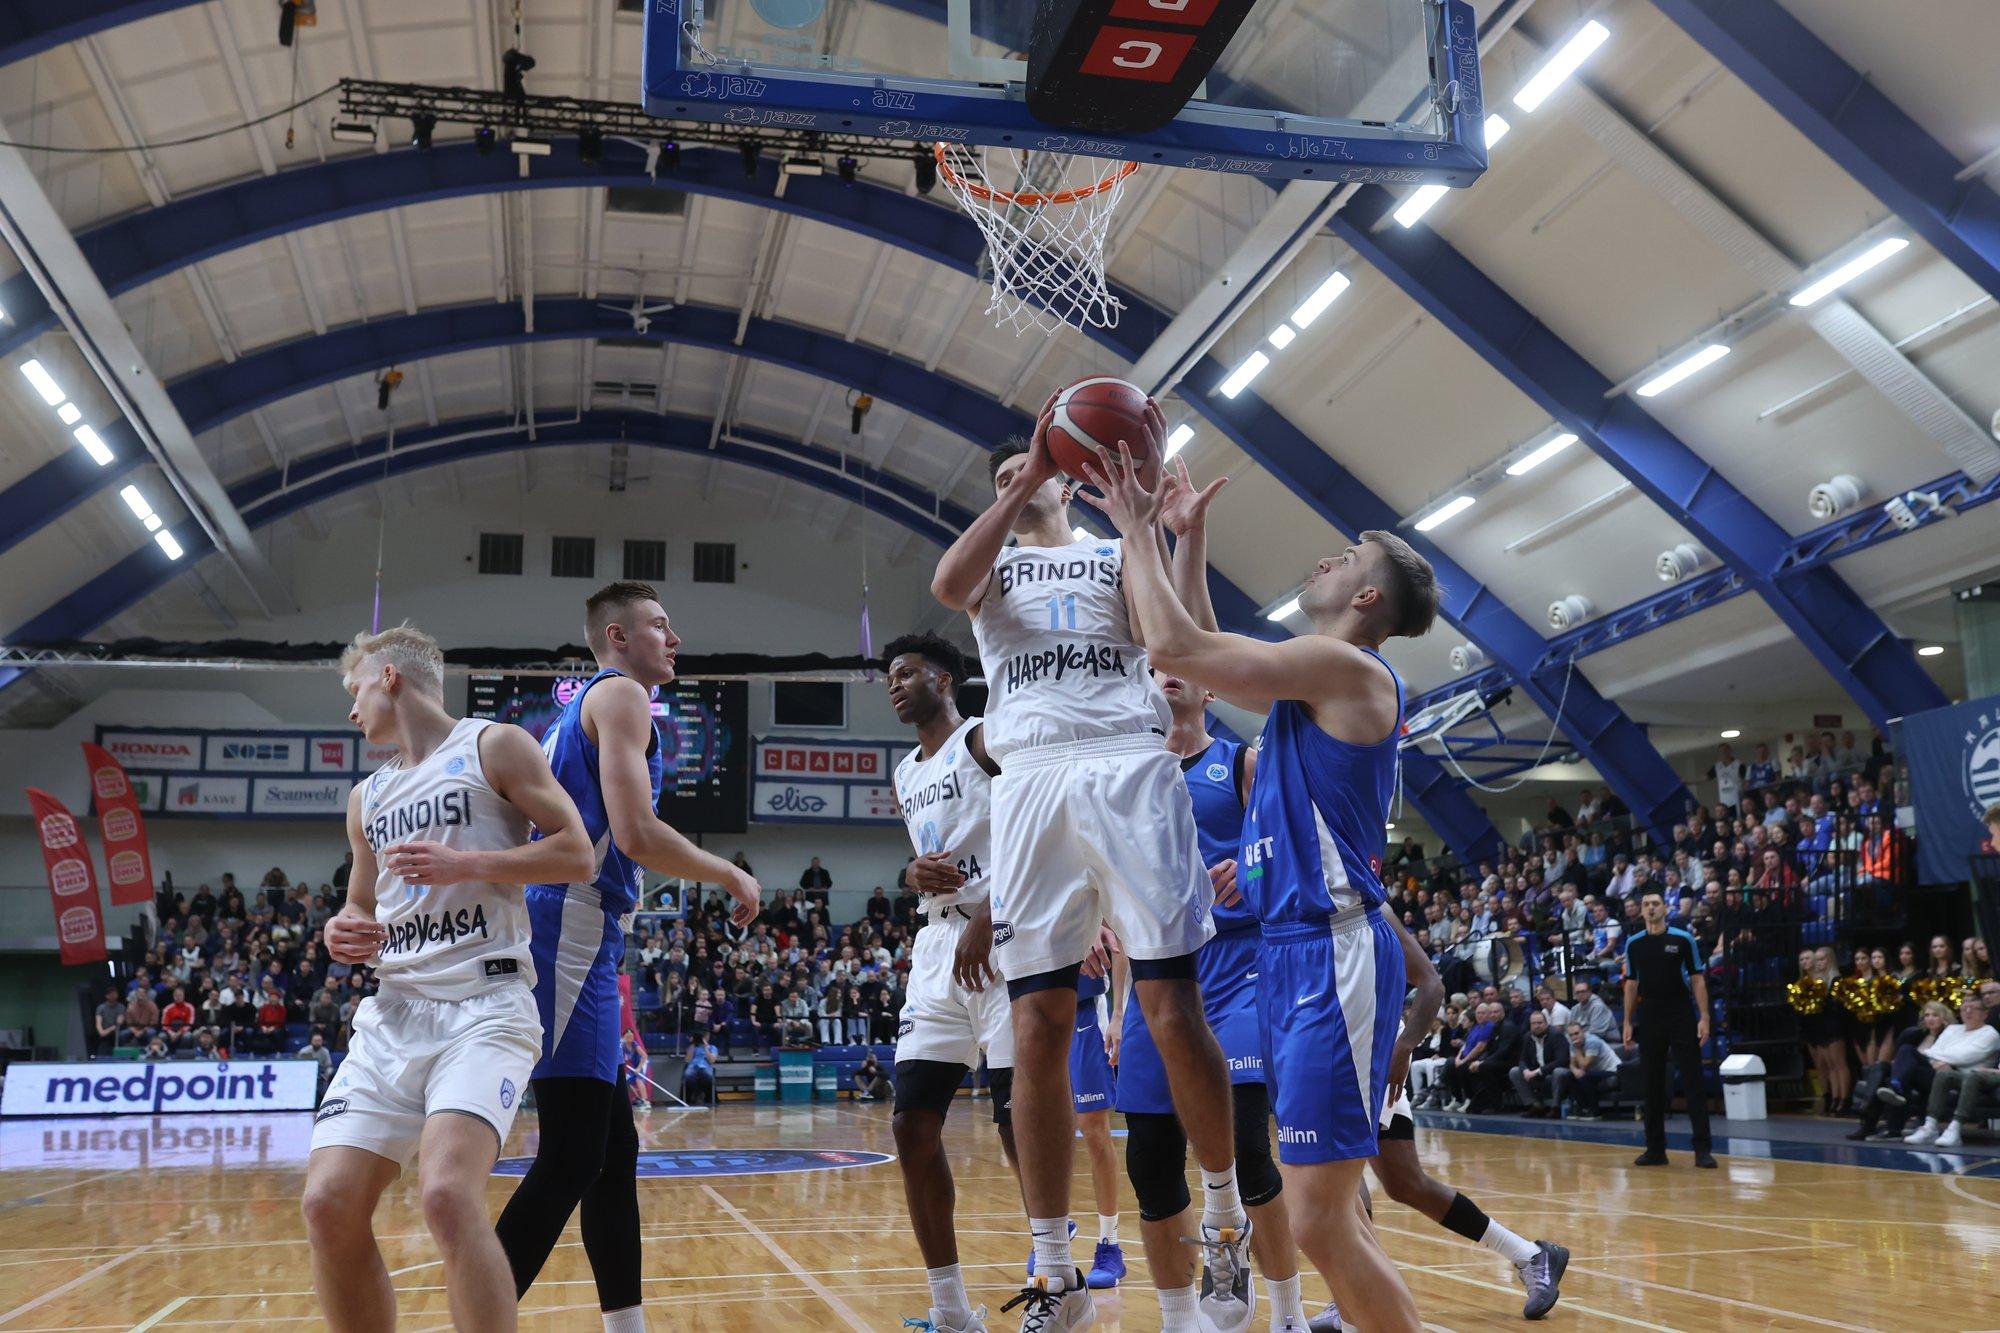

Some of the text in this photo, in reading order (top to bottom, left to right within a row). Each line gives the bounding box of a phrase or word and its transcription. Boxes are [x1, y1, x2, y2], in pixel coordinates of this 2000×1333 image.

[1045, 594, 1076, 632] 11
[111, 742, 192, 757] HONDA
[766, 752, 874, 771] CRAMO
[266, 786, 339, 801] Scanweld
[768, 786, 828, 813] elisa
[379, 903, 488, 957] APPYCASA
[46, 1065, 277, 1112] medpoint
[1076, 1093, 1105, 1103] Tallinn
